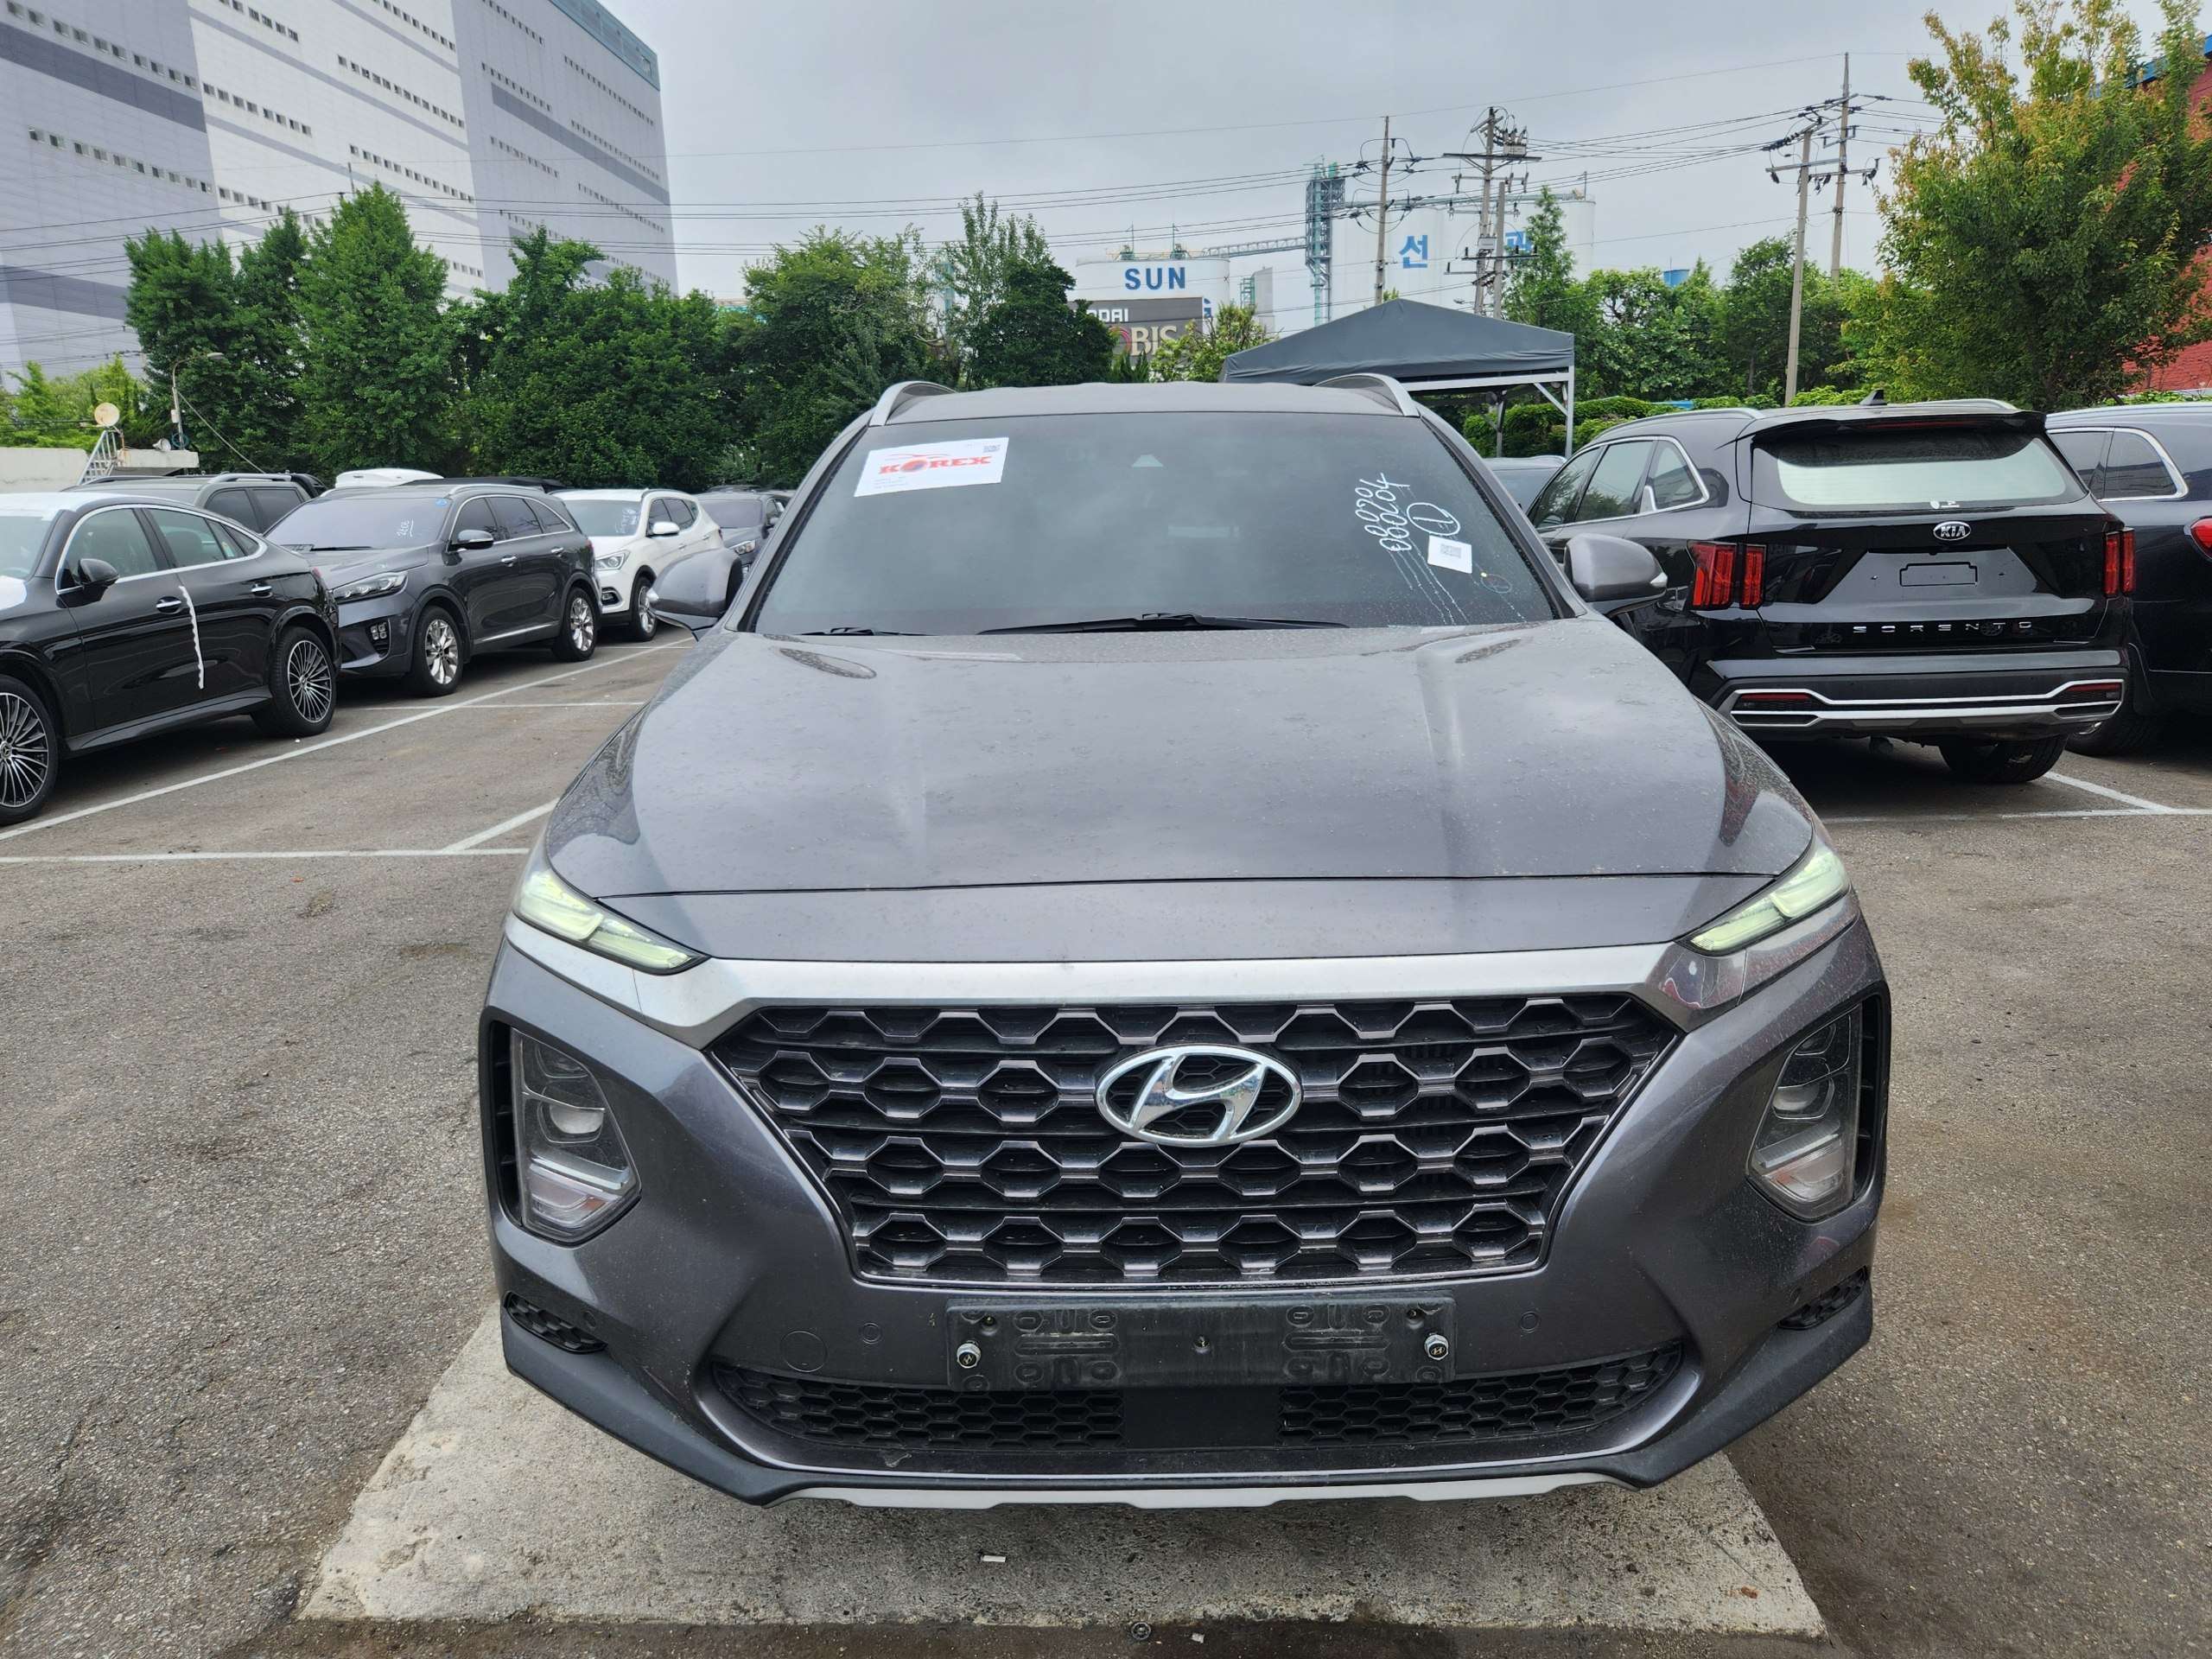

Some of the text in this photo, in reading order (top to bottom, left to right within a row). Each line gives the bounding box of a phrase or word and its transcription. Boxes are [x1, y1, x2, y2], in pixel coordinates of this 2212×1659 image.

[1399, 234, 1428, 269] 선
[1124, 267, 1185, 290] SUN
[878, 455, 993, 474] KOREX
[1940, 525, 1966, 537] KIA
[1853, 621, 2032, 633] SORENTO
